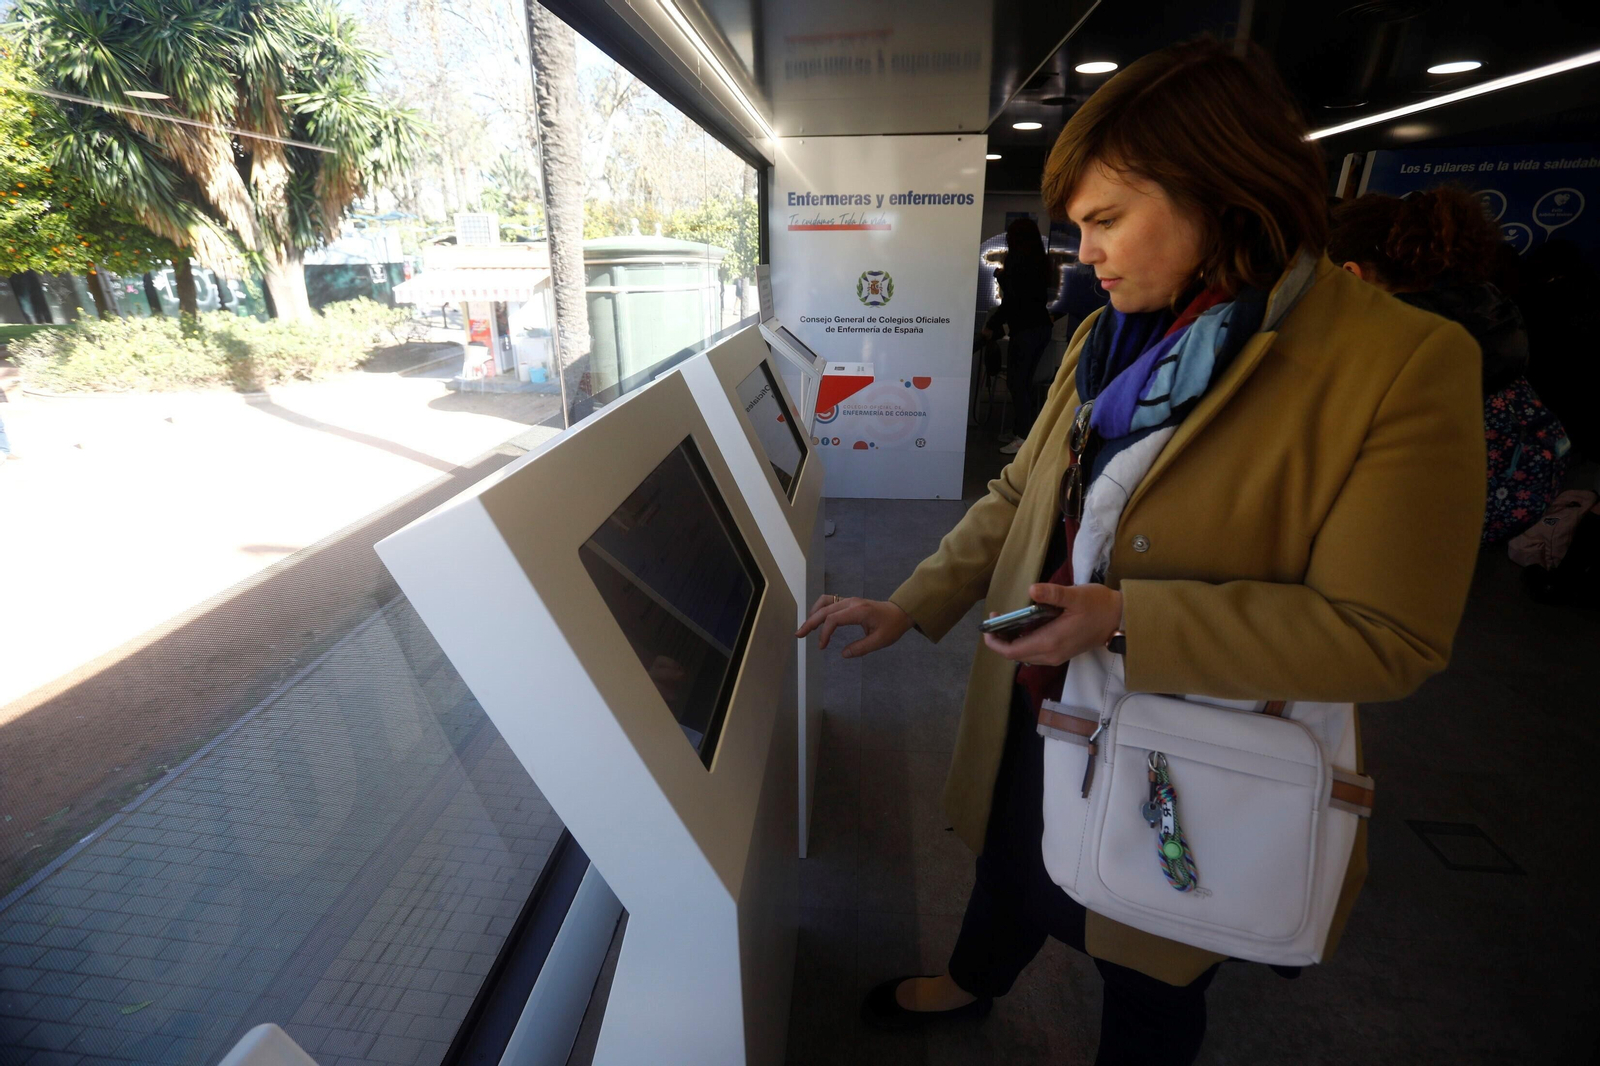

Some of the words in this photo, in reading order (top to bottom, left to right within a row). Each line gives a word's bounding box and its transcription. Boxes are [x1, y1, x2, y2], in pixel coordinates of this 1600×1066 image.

[1400, 164, 1420, 174] Los
[1423, 163, 1431, 173] 5
[1433, 162, 1475, 175] pilares
[1478, 161, 1494, 172] de
[1497, 161, 1509, 171] la
[1513, 159, 1540, 171] vida
[787, 191, 872, 207] Enfermeras
[875, 194, 885, 209] y
[889, 190, 975, 206] enfermeros
[788, 213, 799, 226] Te
[801, 212, 835, 226] cuidamos
[839, 212, 857, 226] Toda
[800, 316, 832, 325] Consejo
[834, 316, 865, 324] General
[866, 316, 877, 324] de
[879, 316, 914, 325] Colegios
[915, 316, 950, 324] Oficiales
[837, 325, 880, 334] Enfermería
[882, 326, 893, 334] de
[894, 326, 924, 335] España
[895, 409, 927, 417] CÓRDOBA
